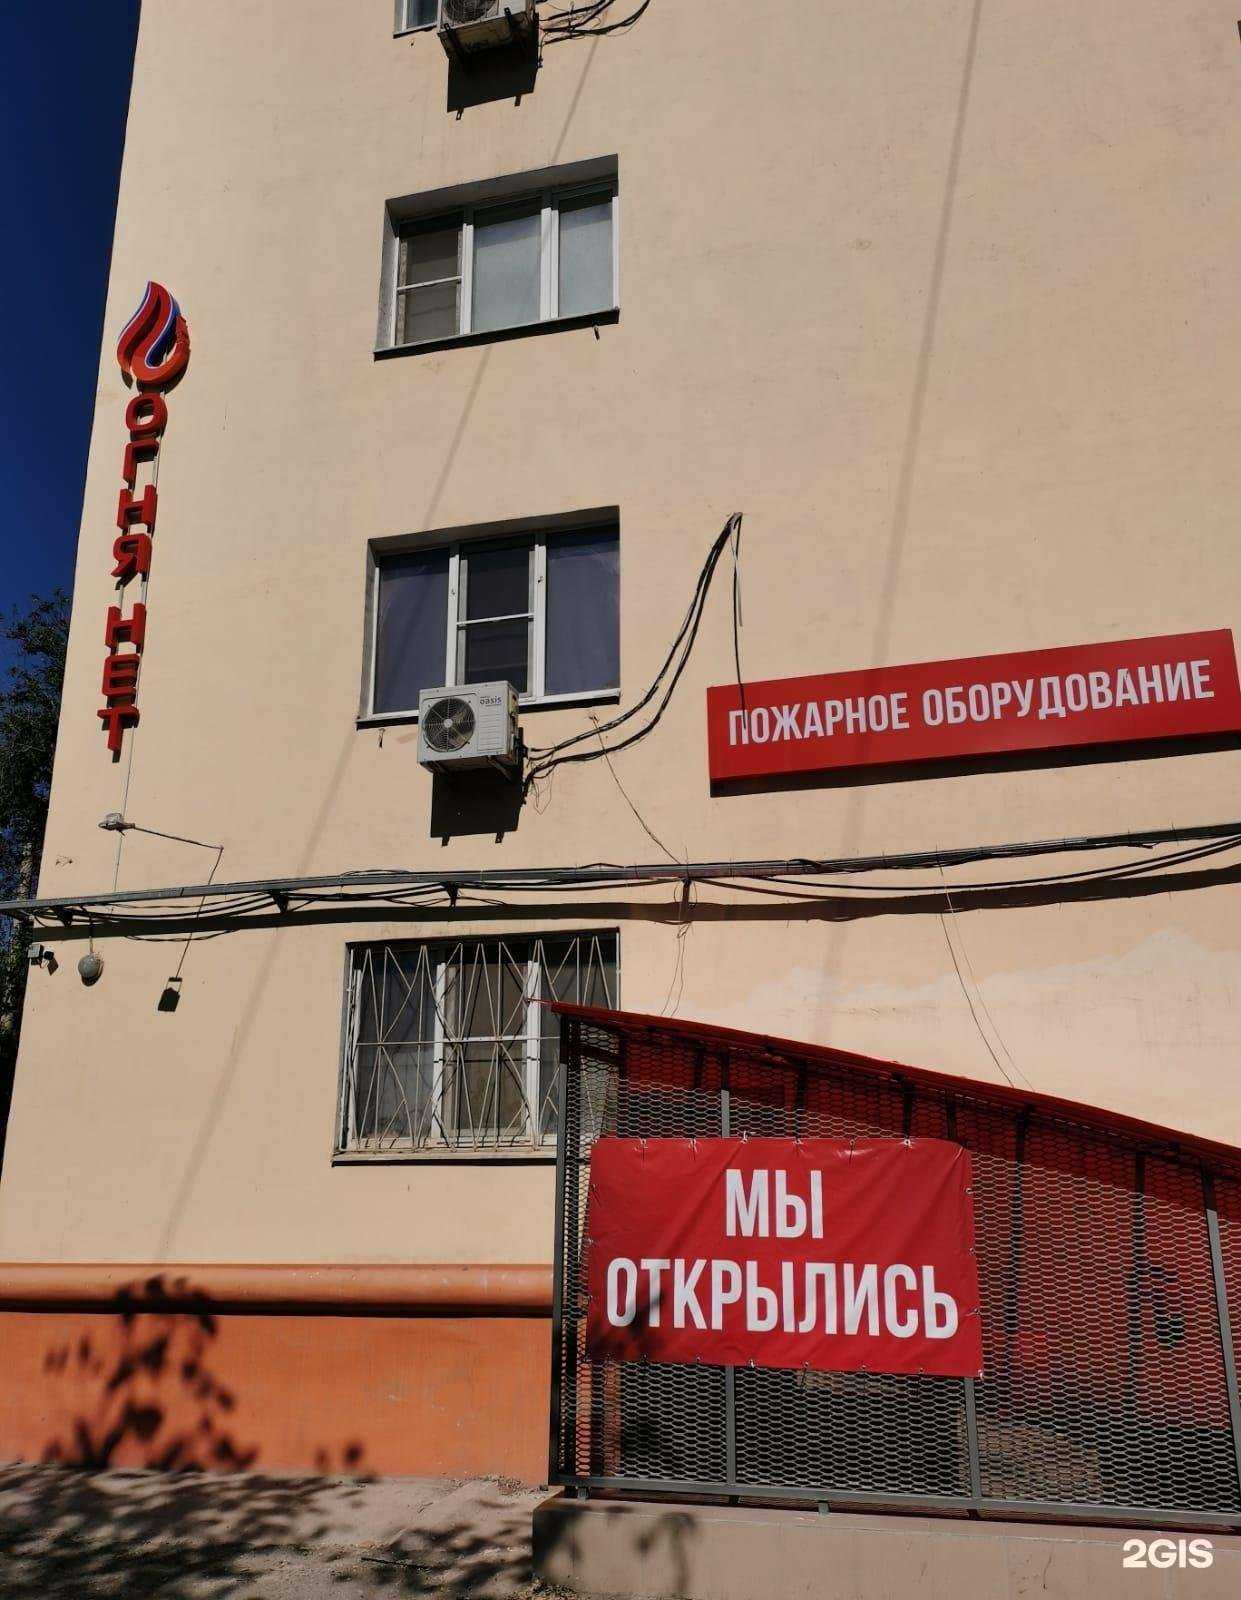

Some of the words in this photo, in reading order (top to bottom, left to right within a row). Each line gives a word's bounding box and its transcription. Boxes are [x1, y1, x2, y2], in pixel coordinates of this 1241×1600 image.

[480, 696, 502, 705] oasis
[728, 692, 910, 746] ПОЖАРНОЕ
[922, 659, 1215, 727] ОБОРУДОВАНИЕ
[725, 1168, 824, 1239] МЫ
[606, 1257, 959, 1339] ОТКРЫЛИСЬ
